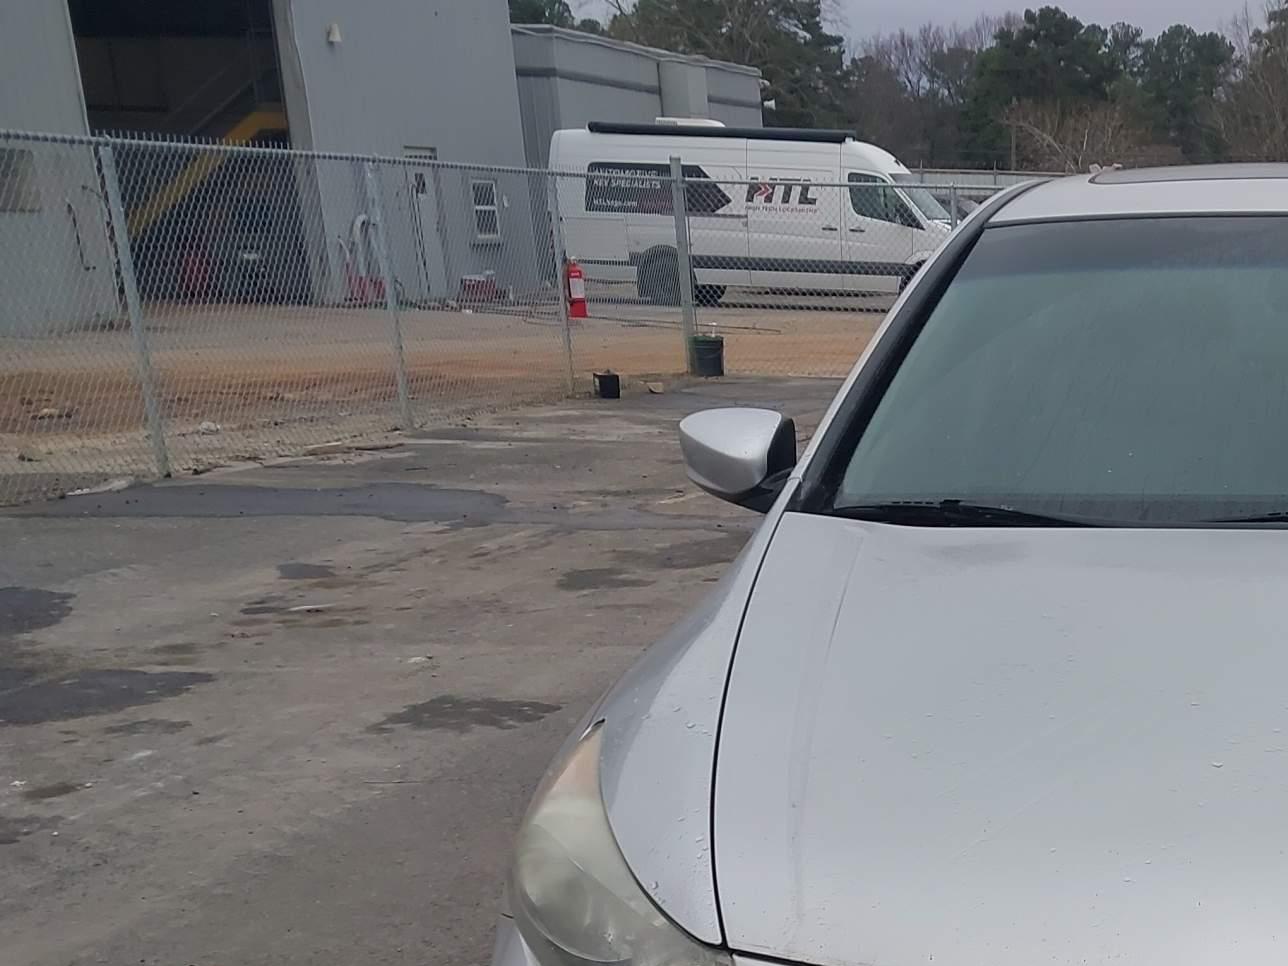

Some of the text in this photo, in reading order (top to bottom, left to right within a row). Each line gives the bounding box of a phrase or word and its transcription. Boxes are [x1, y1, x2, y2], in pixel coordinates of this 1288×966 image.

[593, 179, 661, 190] KEY SPECIALISTS
[745, 177, 817, 205] HTL
